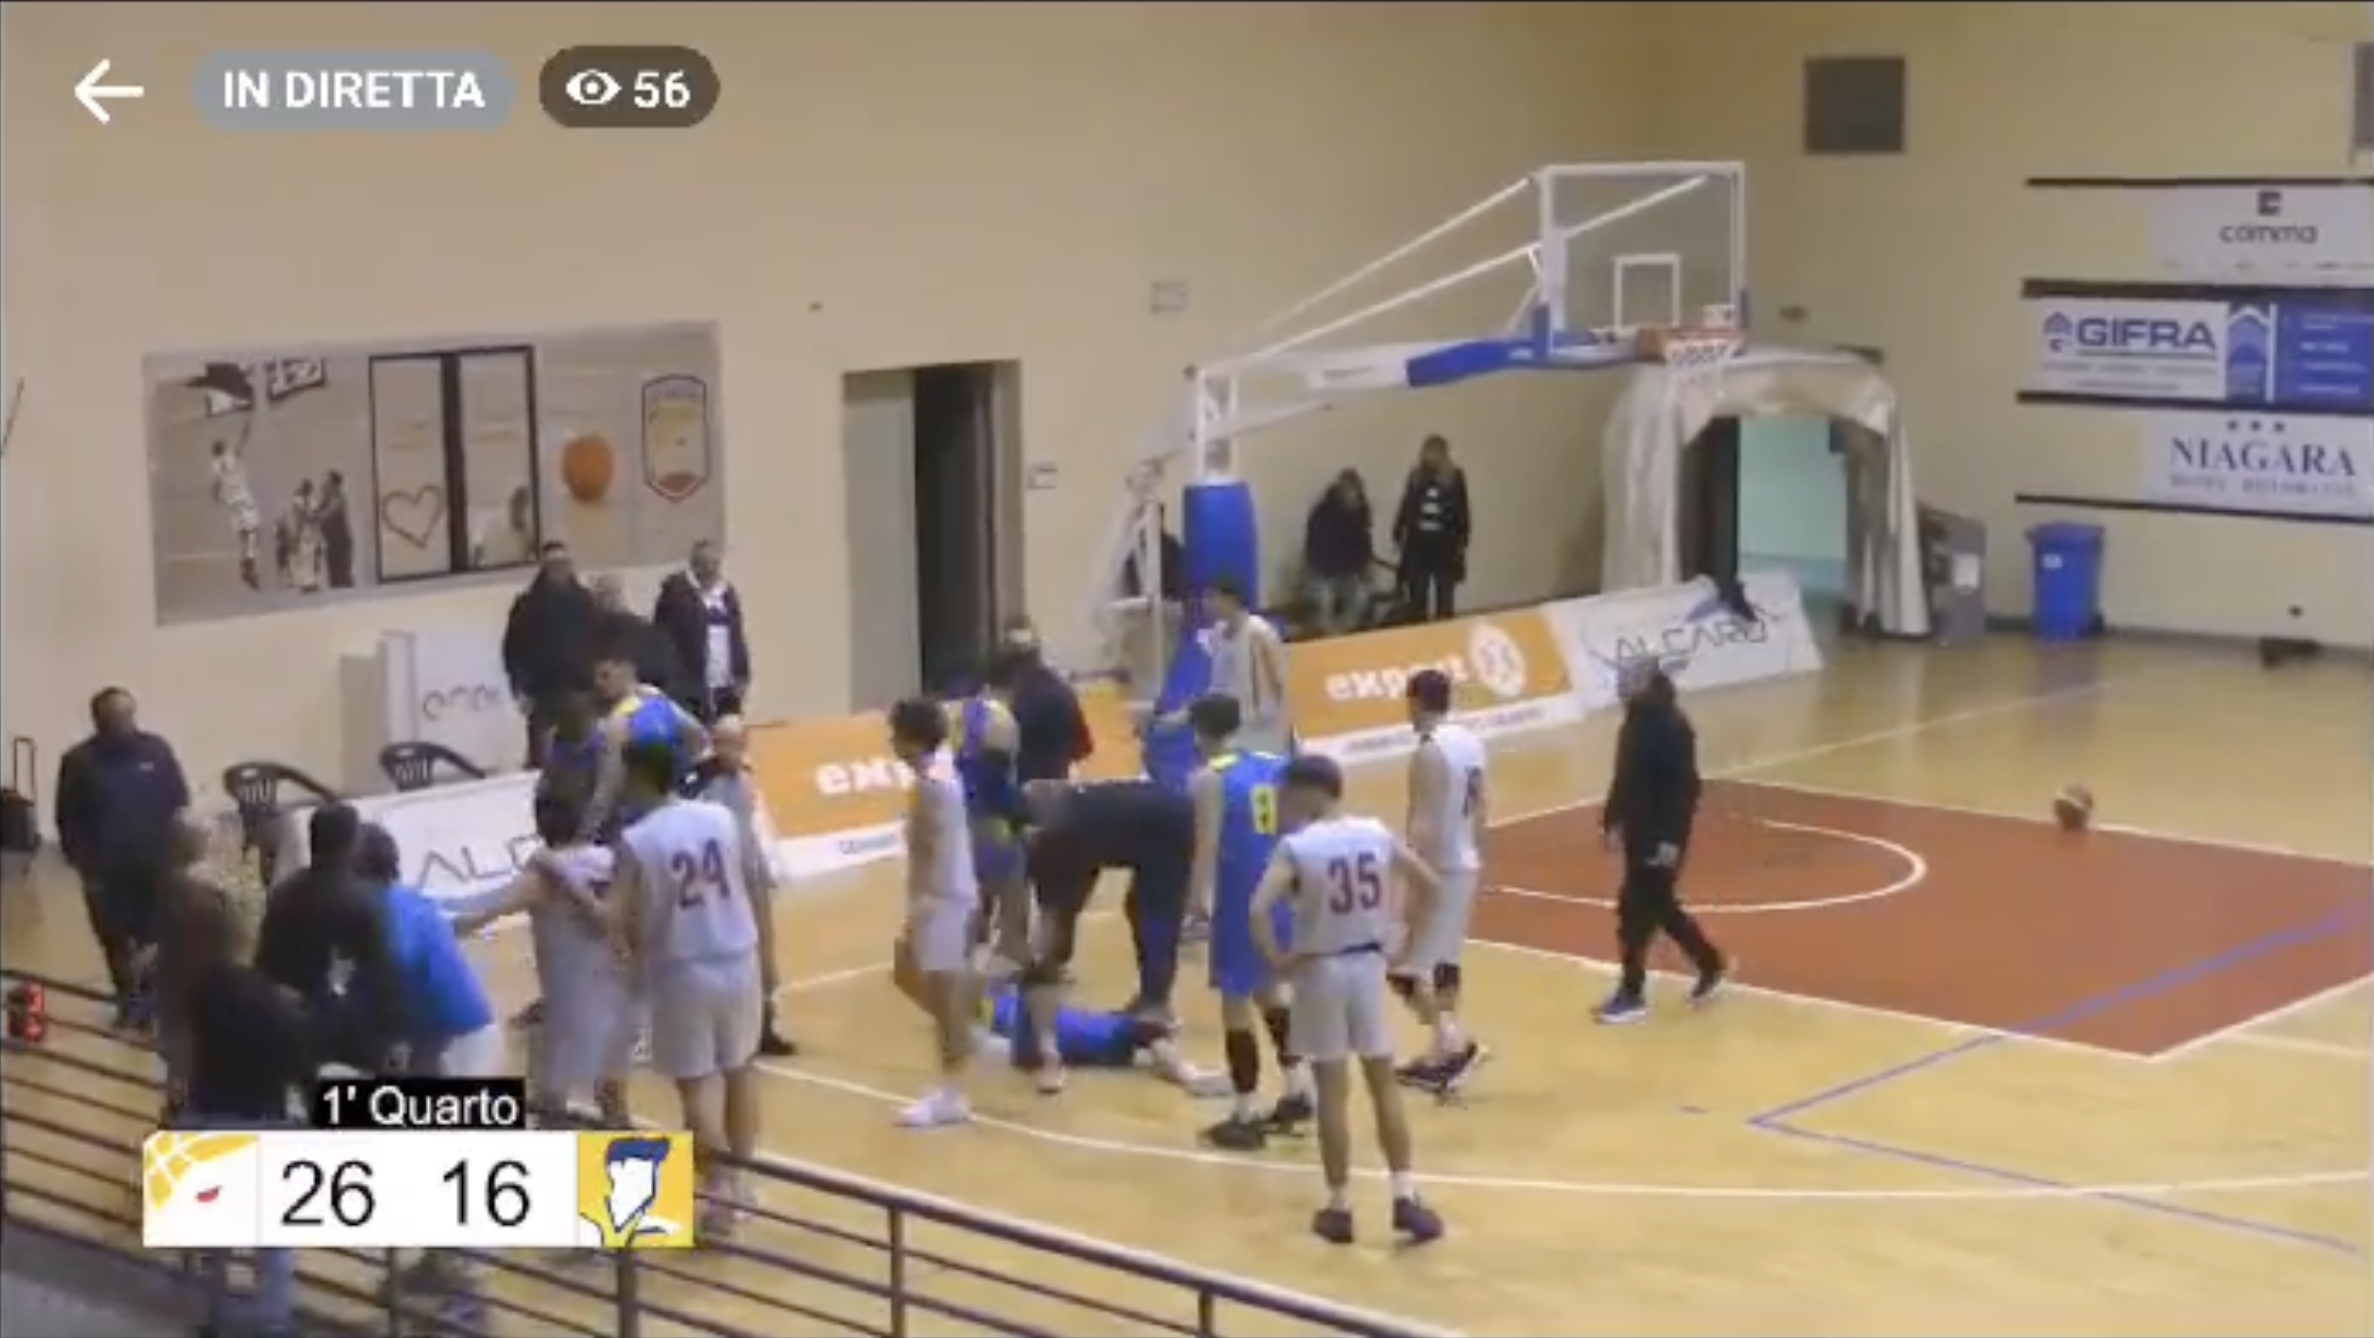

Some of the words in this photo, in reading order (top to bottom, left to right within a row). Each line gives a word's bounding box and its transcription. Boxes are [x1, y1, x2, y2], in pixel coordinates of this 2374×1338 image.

[2219, 225, 2318, 244] comma
[2076, 316, 2217, 351] GIFRA
[2170, 436, 2357, 477] NIAGARA
[671, 837, 731, 909] 24
[1327, 850, 1381, 915] 35
